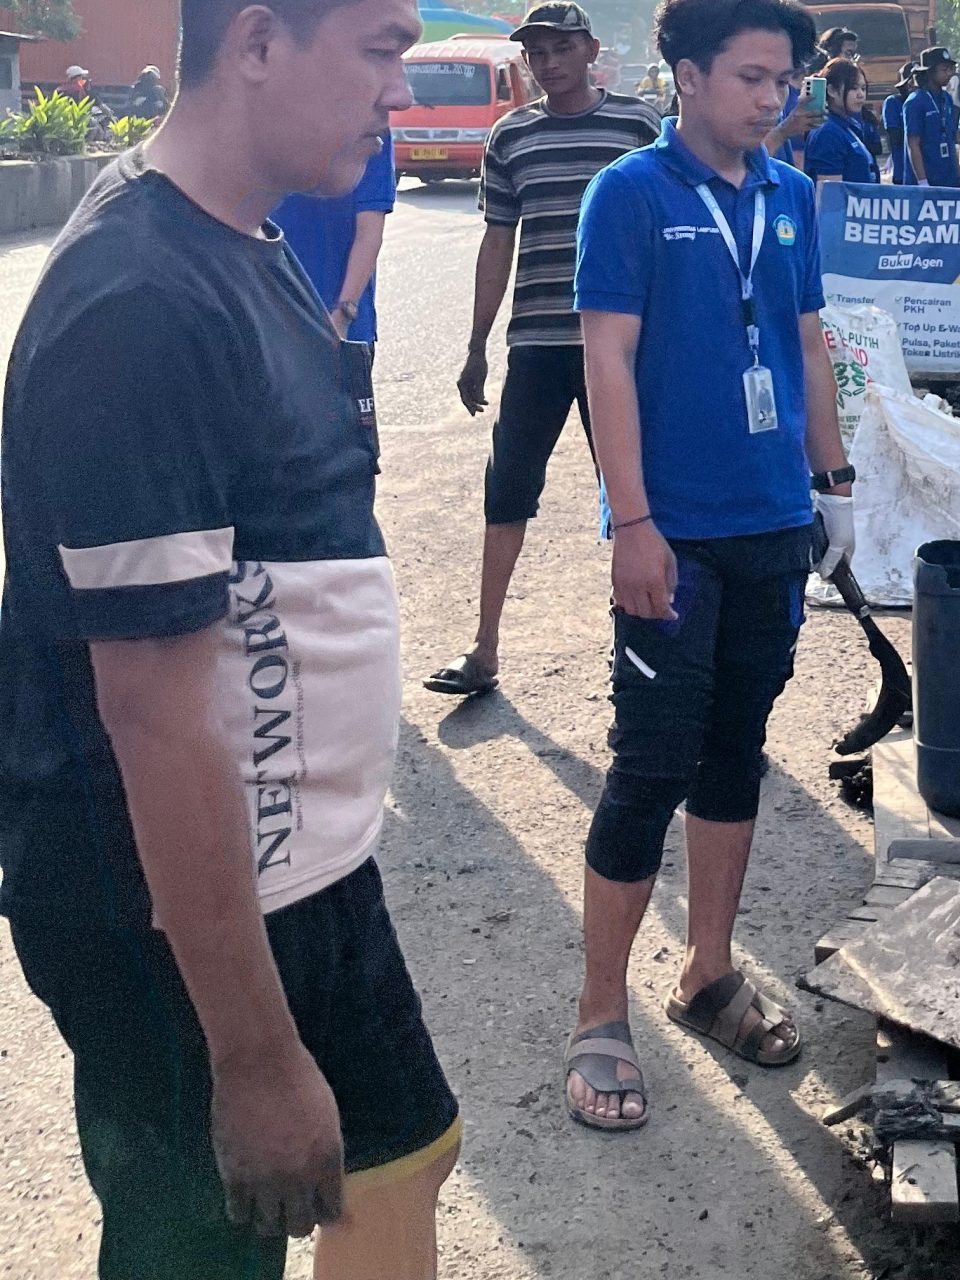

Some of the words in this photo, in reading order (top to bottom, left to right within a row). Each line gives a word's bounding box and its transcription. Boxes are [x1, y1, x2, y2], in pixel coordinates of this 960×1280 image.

[846, 195, 910, 221] MINI
[836, 294, 876, 305] Transfer
[903, 296, 952, 307] Pencairan
[903, 305, 925, 314] PKH
[903, 322, 921, 333] Top
[922, 323, 936, 333] Up
[848, 332, 880, 349] PUTIH
[902, 337, 931, 348] Pulsa,
[933, 339, 960, 349] Paket
